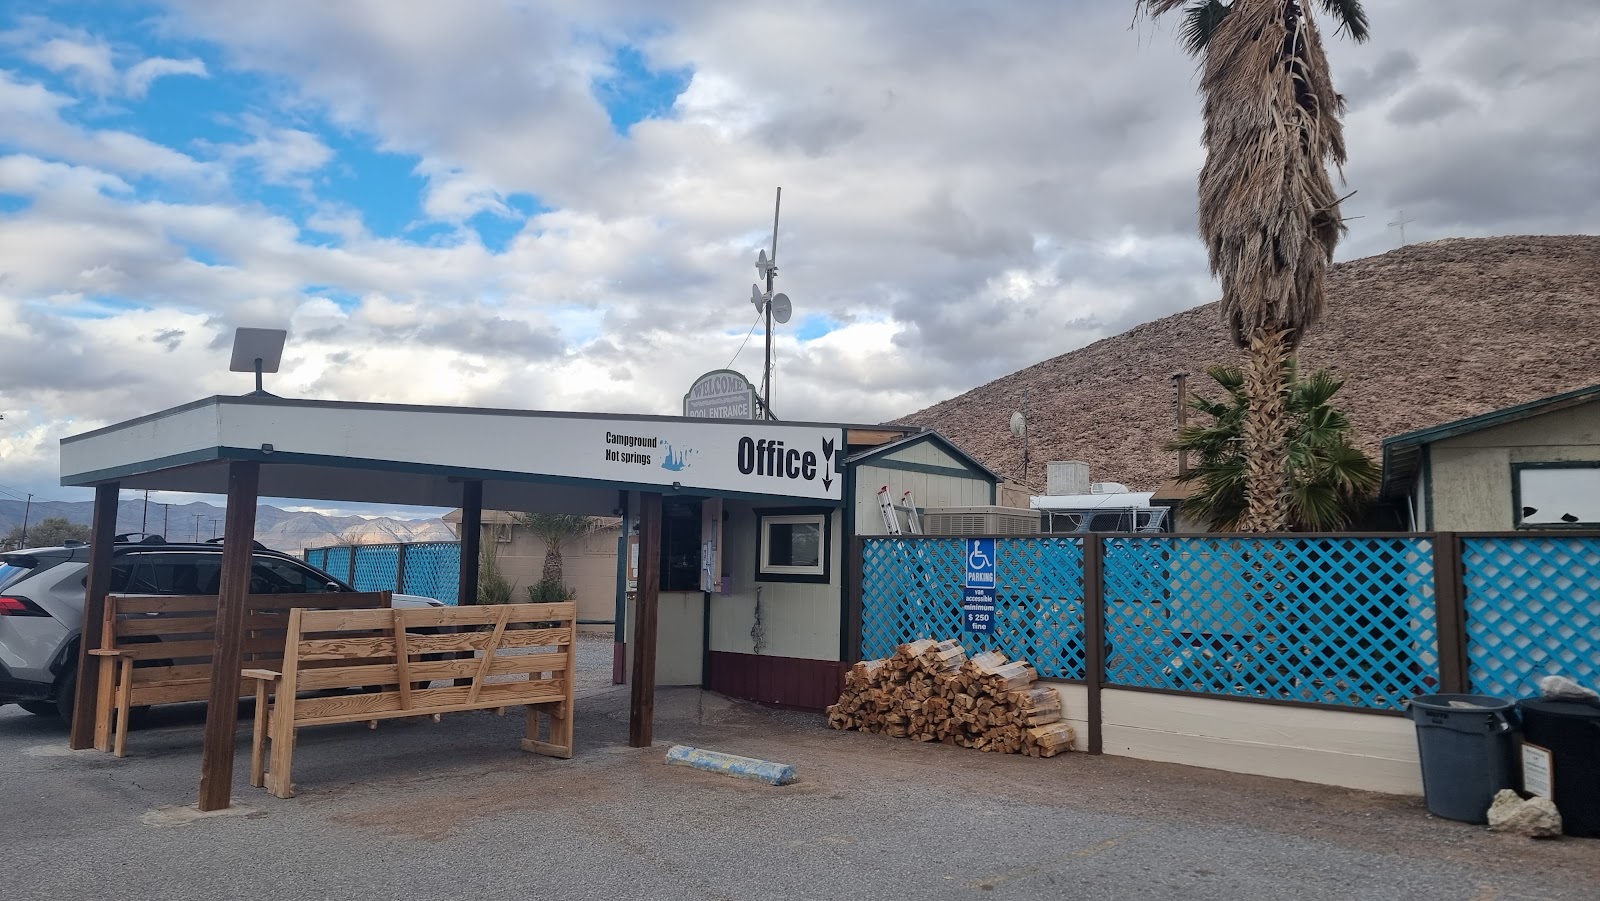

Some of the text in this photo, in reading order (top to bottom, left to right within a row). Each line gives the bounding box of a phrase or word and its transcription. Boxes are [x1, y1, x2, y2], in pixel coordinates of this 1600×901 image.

[694, 376, 743, 398] WELCOME
[709, 404, 748, 418] ENTRANCE
[606, 431, 657, 448] Campground
[605, 449, 651, 466] Hot springs
[738, 436, 817, 481] Office
[968, 572, 993, 582] PARKING
[975, 614, 989, 622] 250
